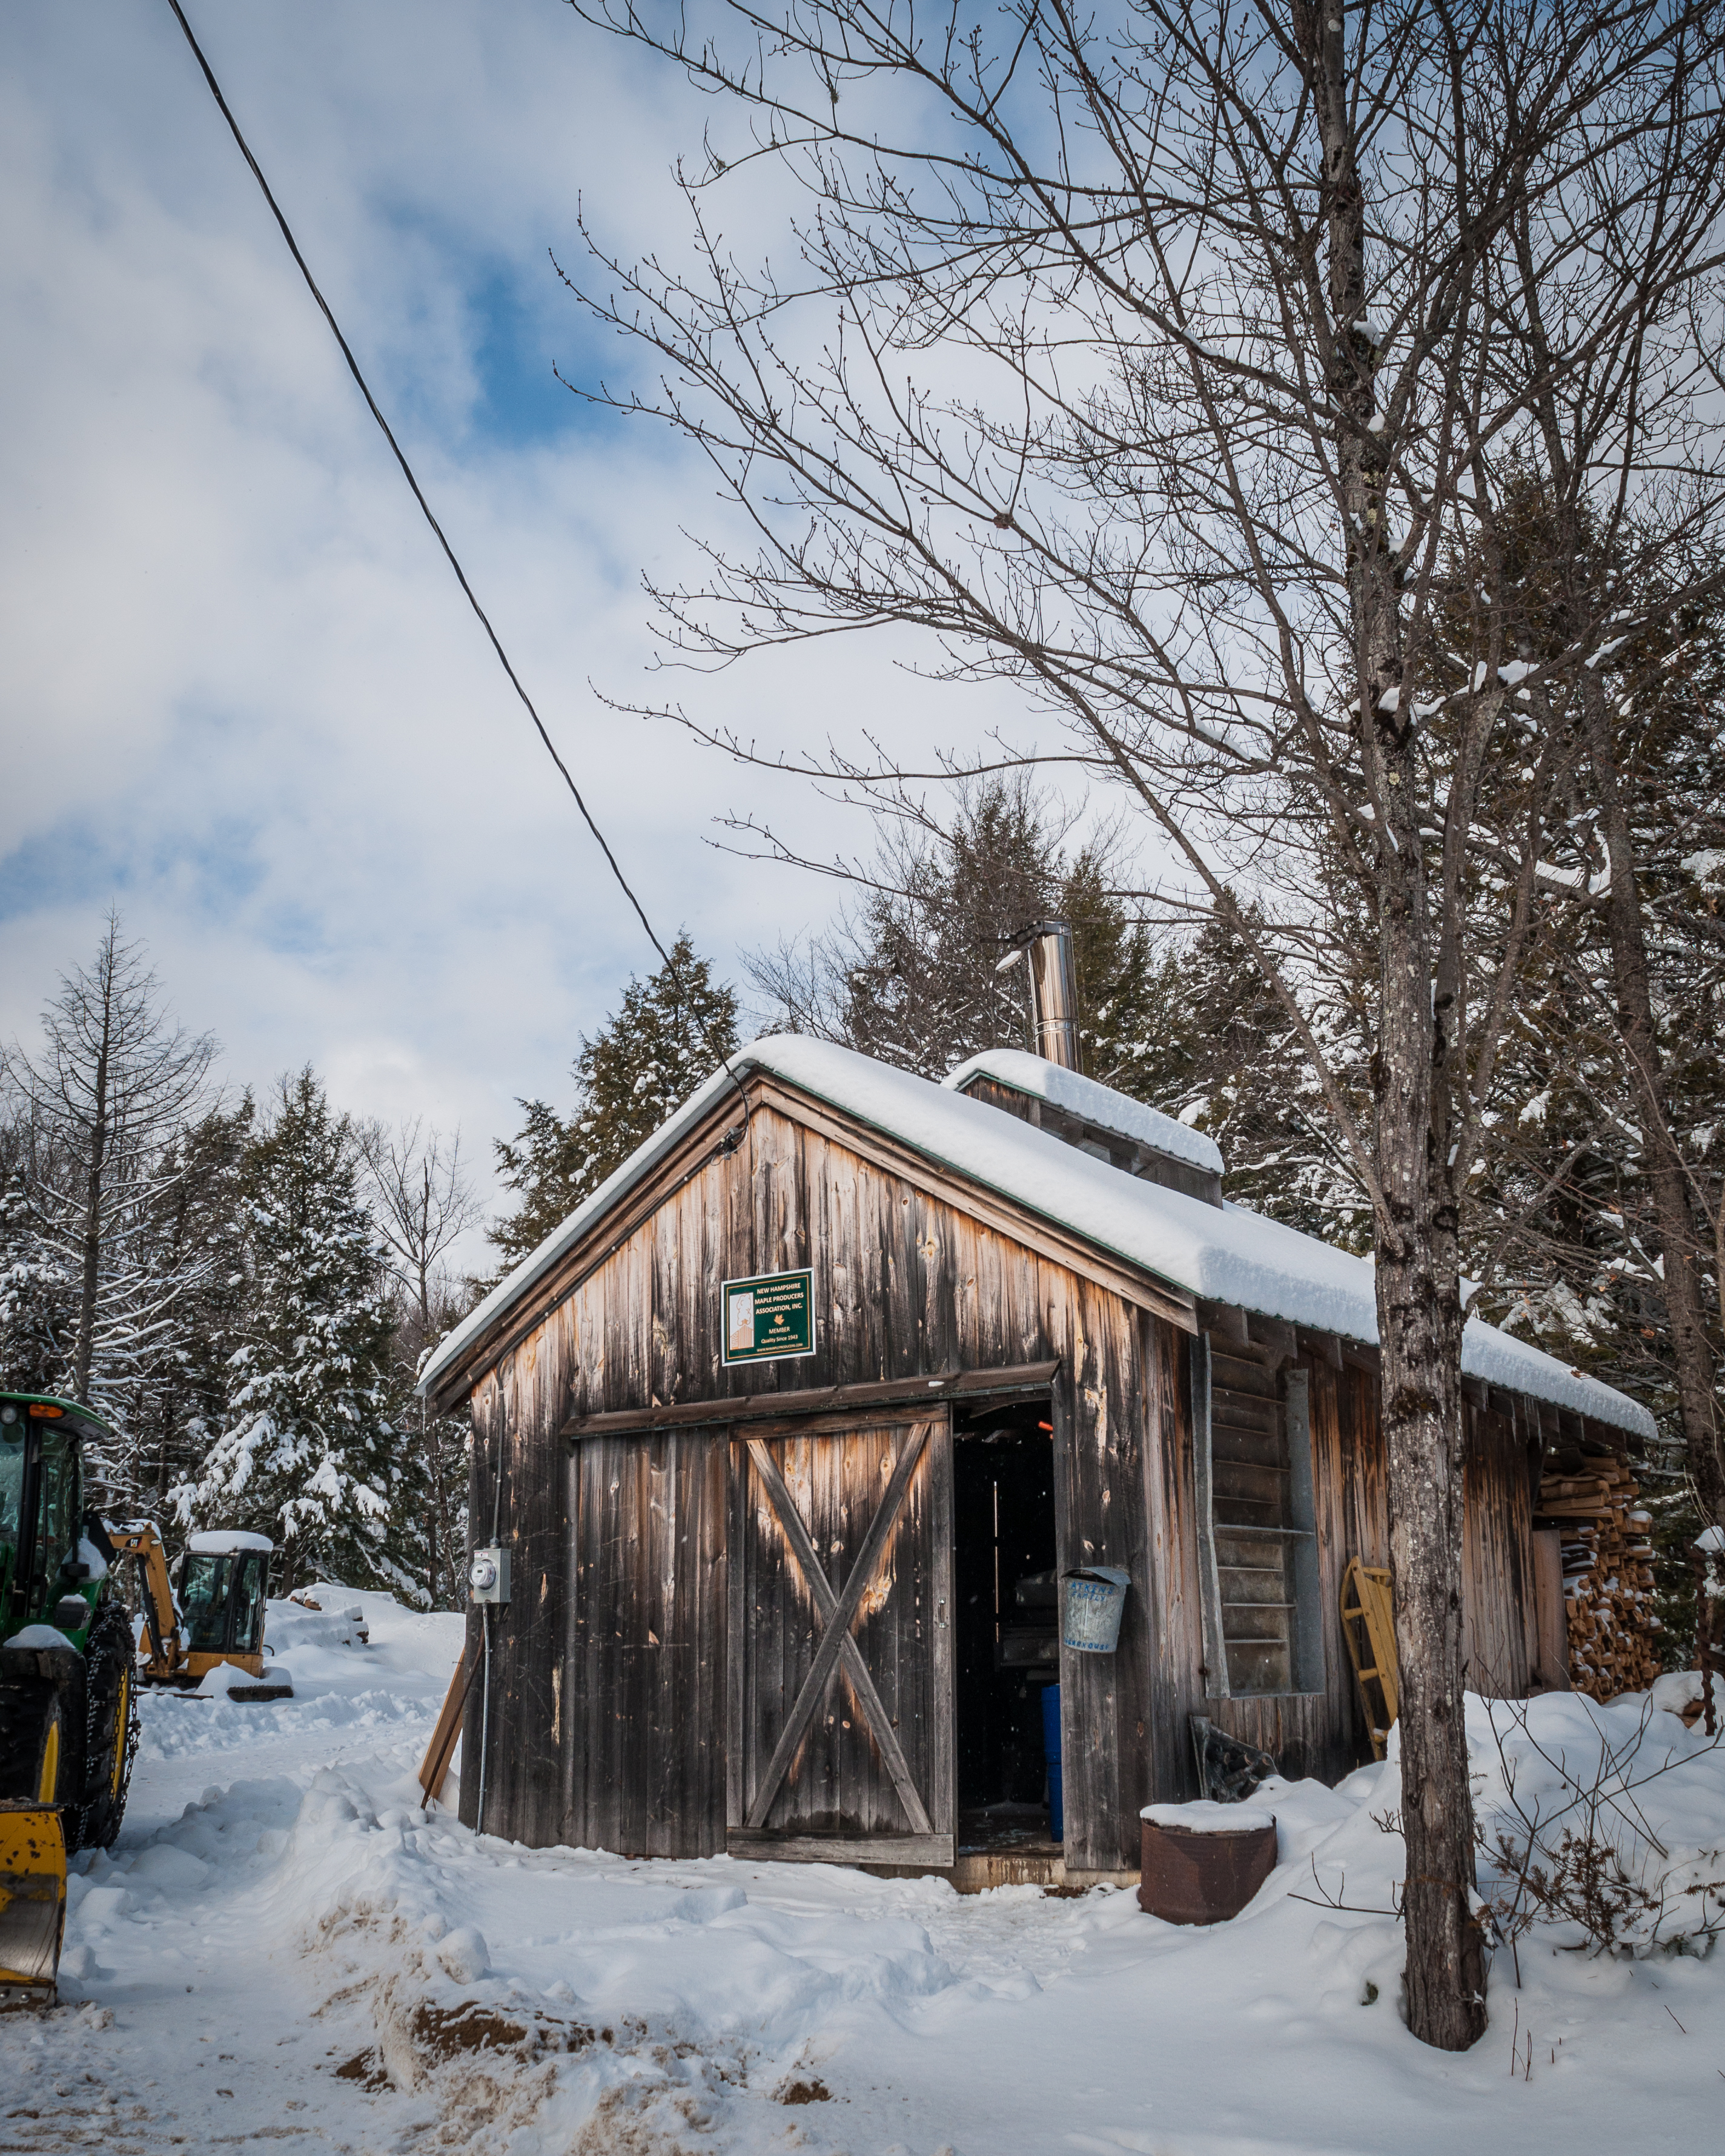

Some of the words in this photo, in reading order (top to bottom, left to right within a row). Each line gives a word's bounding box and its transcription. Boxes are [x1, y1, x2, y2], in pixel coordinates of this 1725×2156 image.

[770, 1282, 801, 1292] HAMPSHIRE
[754, 1297, 772, 1305] MAPLE
[773, 1292, 804, 1302] PRODUCERS
[755, 1305, 791, 1315] ASSOCIATION,
[130, 1539, 139, 1547] CAT
[1071, 1581, 1115, 1595] ATKINS
[1071, 1590, 1106, 1602] FAMILY
